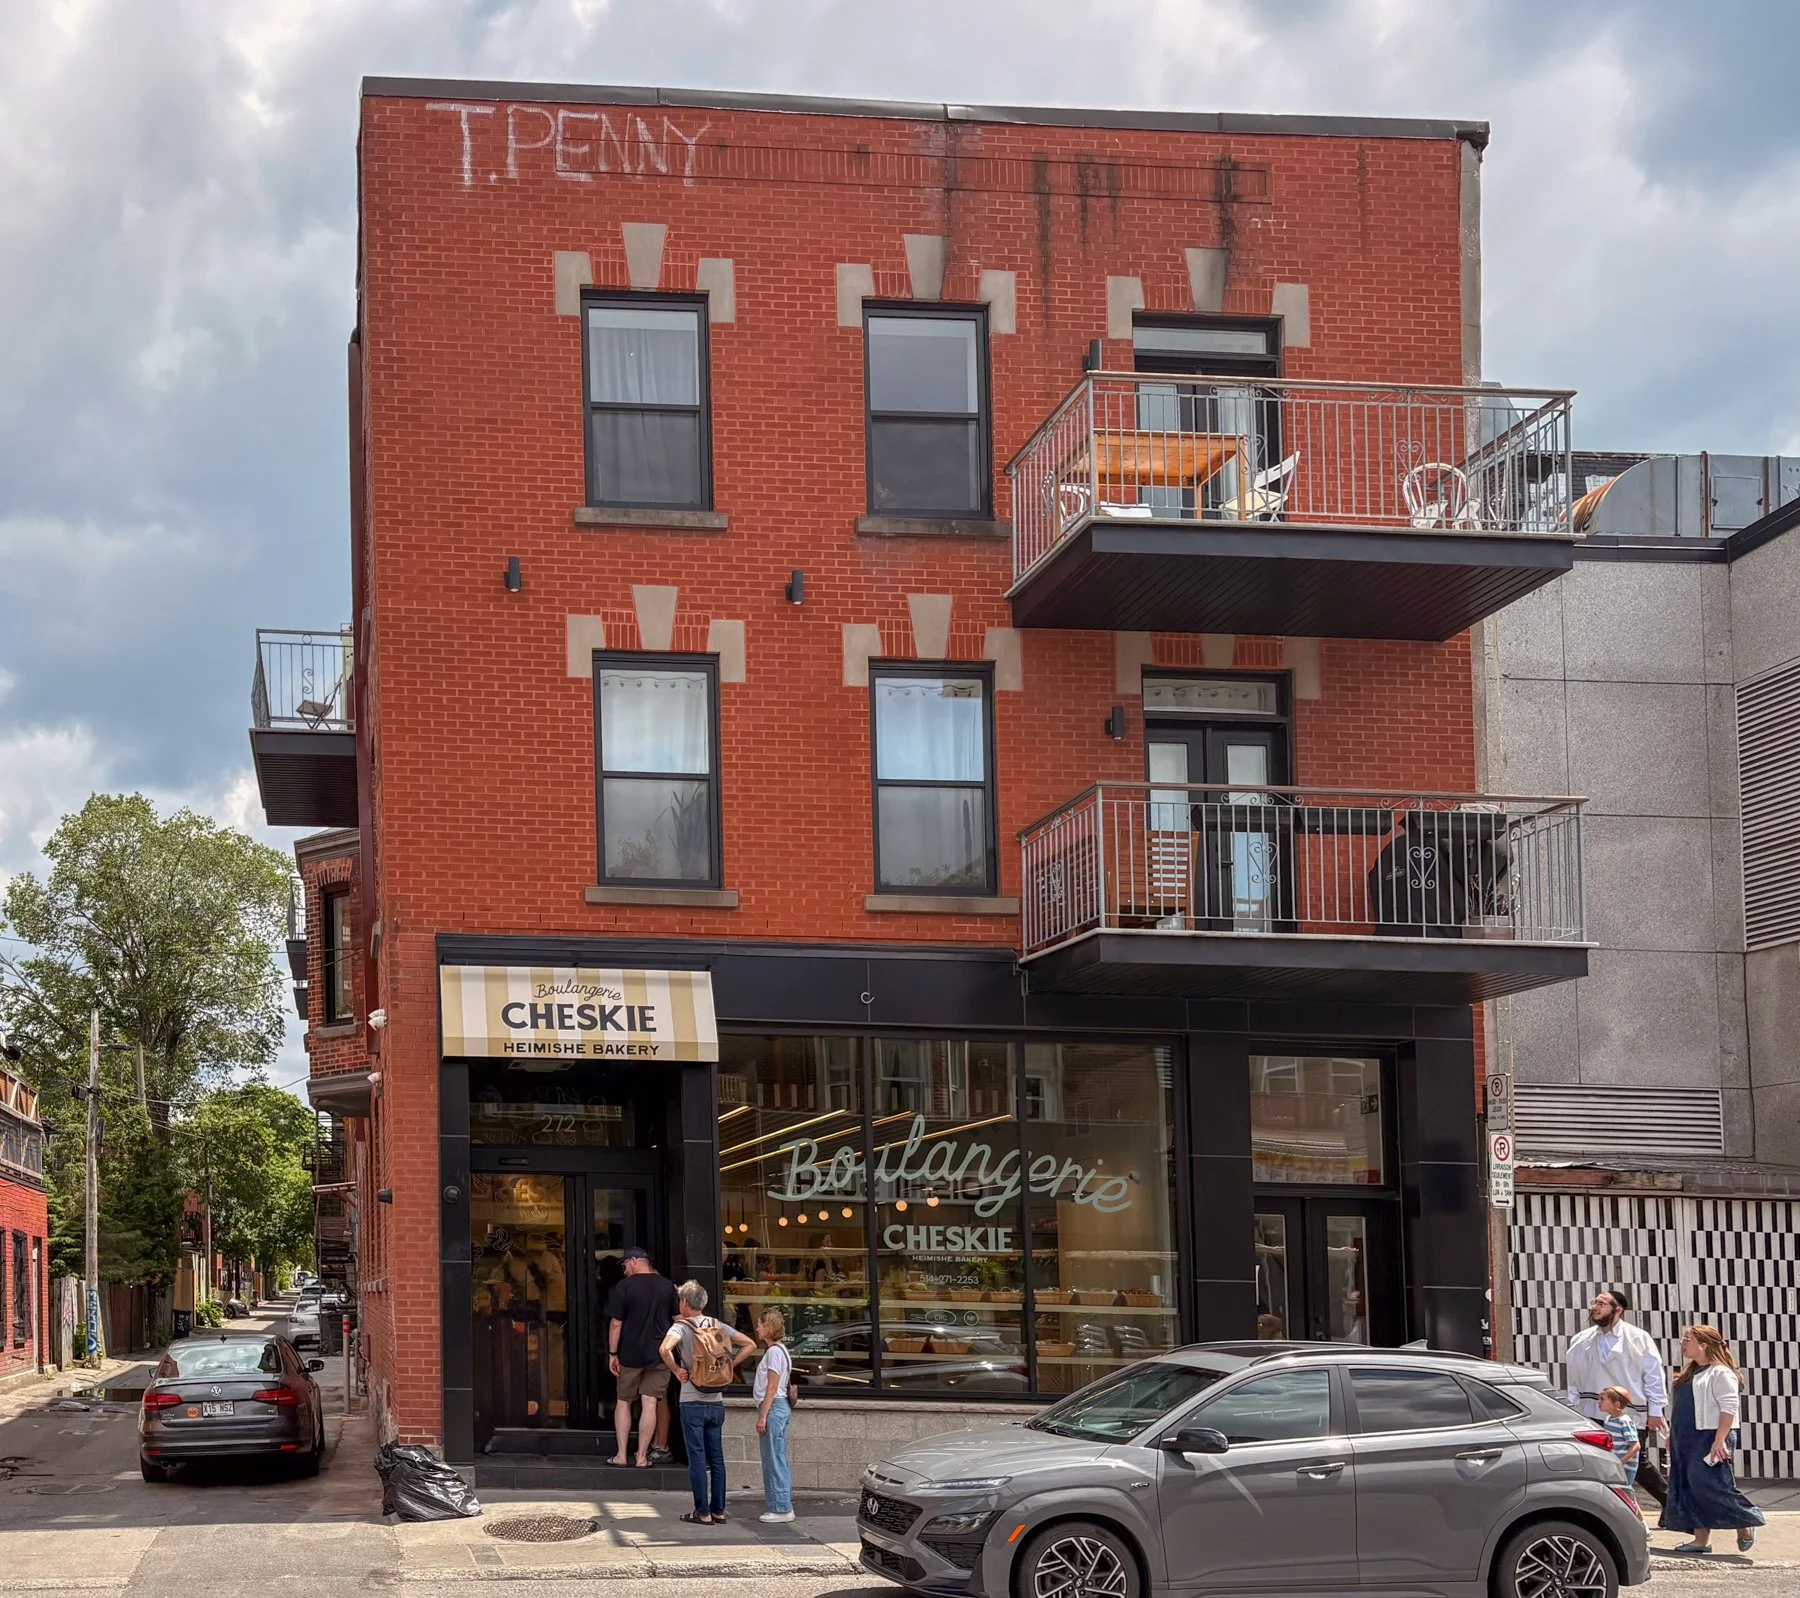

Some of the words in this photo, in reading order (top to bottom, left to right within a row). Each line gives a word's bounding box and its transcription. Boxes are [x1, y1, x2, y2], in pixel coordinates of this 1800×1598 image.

[533, 978, 622, 1001] Boulangerie
[501, 1002, 658, 1033] CHESKIE
[503, 1042, 587, 1055] HEIMISHE
[592, 1043, 660, 1056] BAKERY
[541, 1114, 577, 1133] 272
[766, 1113, 1133, 1218] Boulangerie
[883, 1224, 1014, 1253] CHESKIE
[912, 1254, 953, 1263] HEIMISHE
[955, 1255, 989, 1264] BAKERY
[919, 1274, 980, 1285] 514-271-2253
